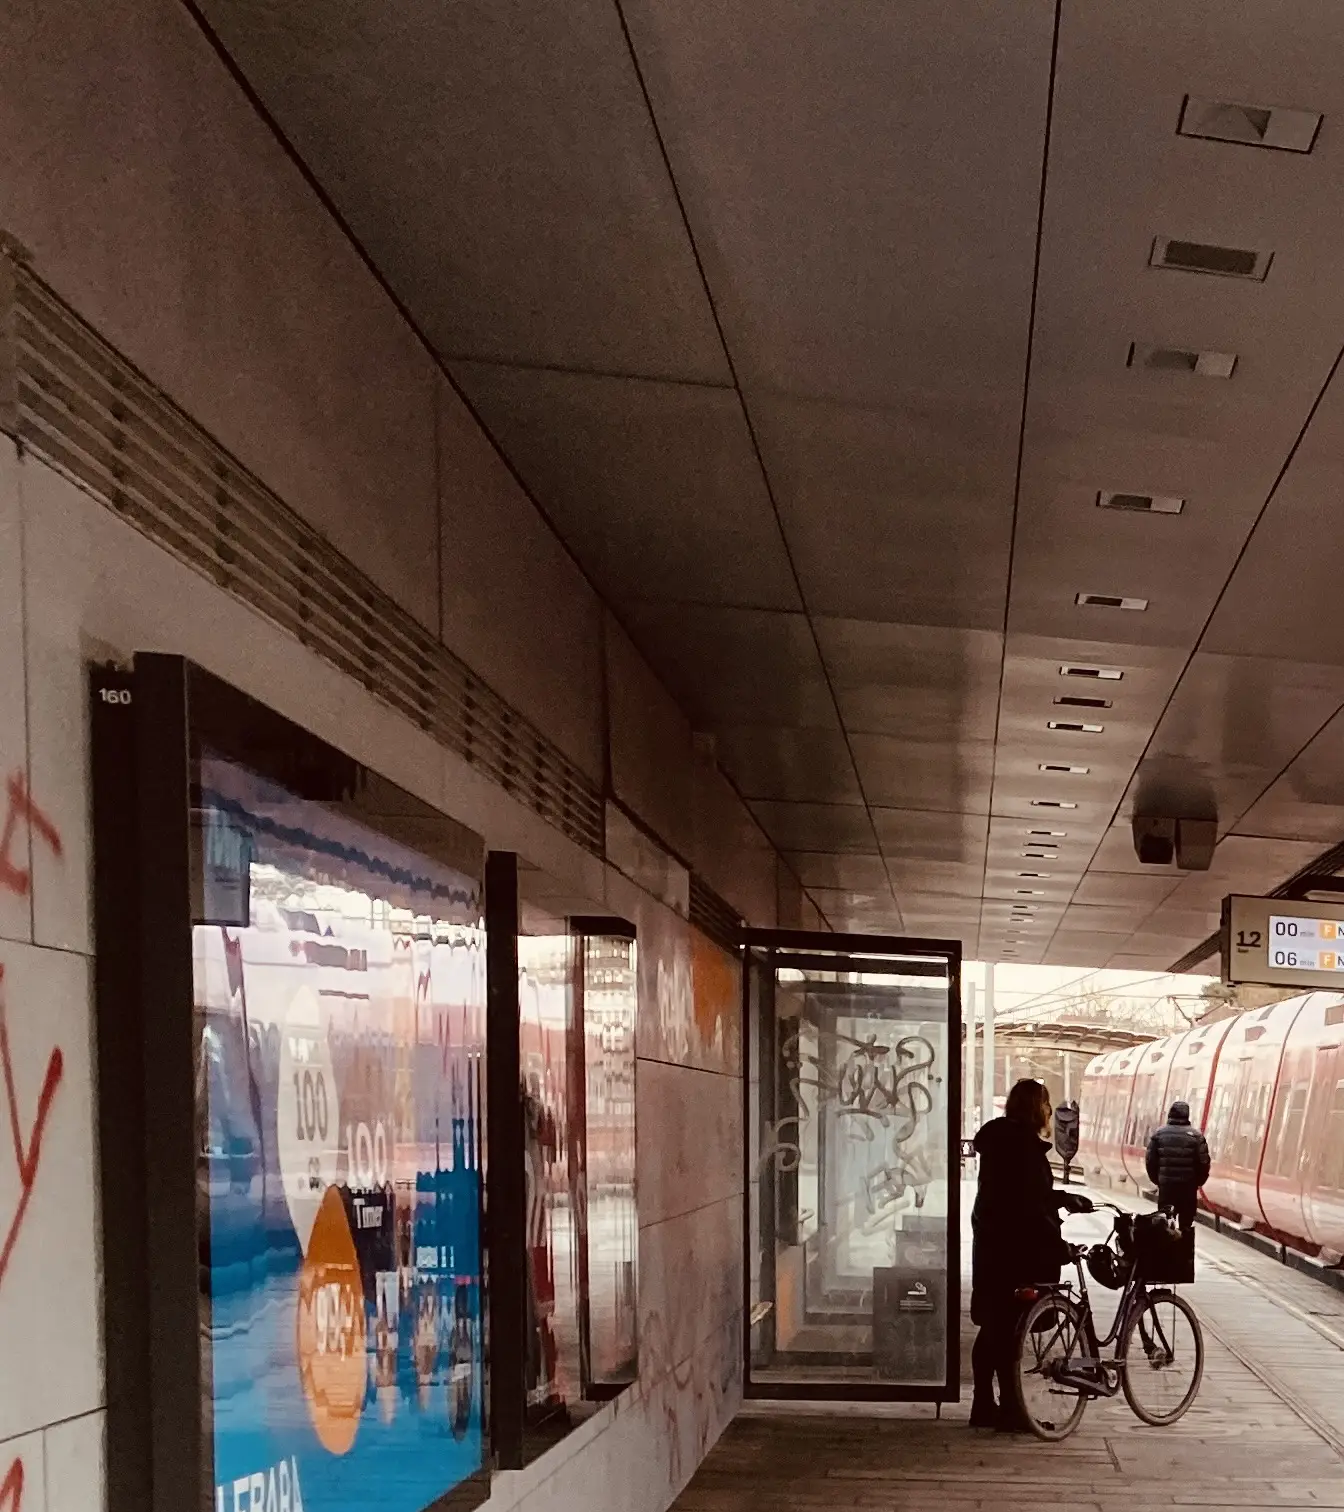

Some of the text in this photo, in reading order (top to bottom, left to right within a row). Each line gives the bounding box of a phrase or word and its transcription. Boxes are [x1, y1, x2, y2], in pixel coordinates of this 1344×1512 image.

[99, 687, 132, 705] 160
[1275, 921, 1298, 937] 00
[1323, 924, 1333, 938] F
[1236, 930, 1262, 948] 12
[1274, 951, 1297, 966] 06
[1323, 954, 1333, 967] F
[293, 1070, 328, 1142] 100
